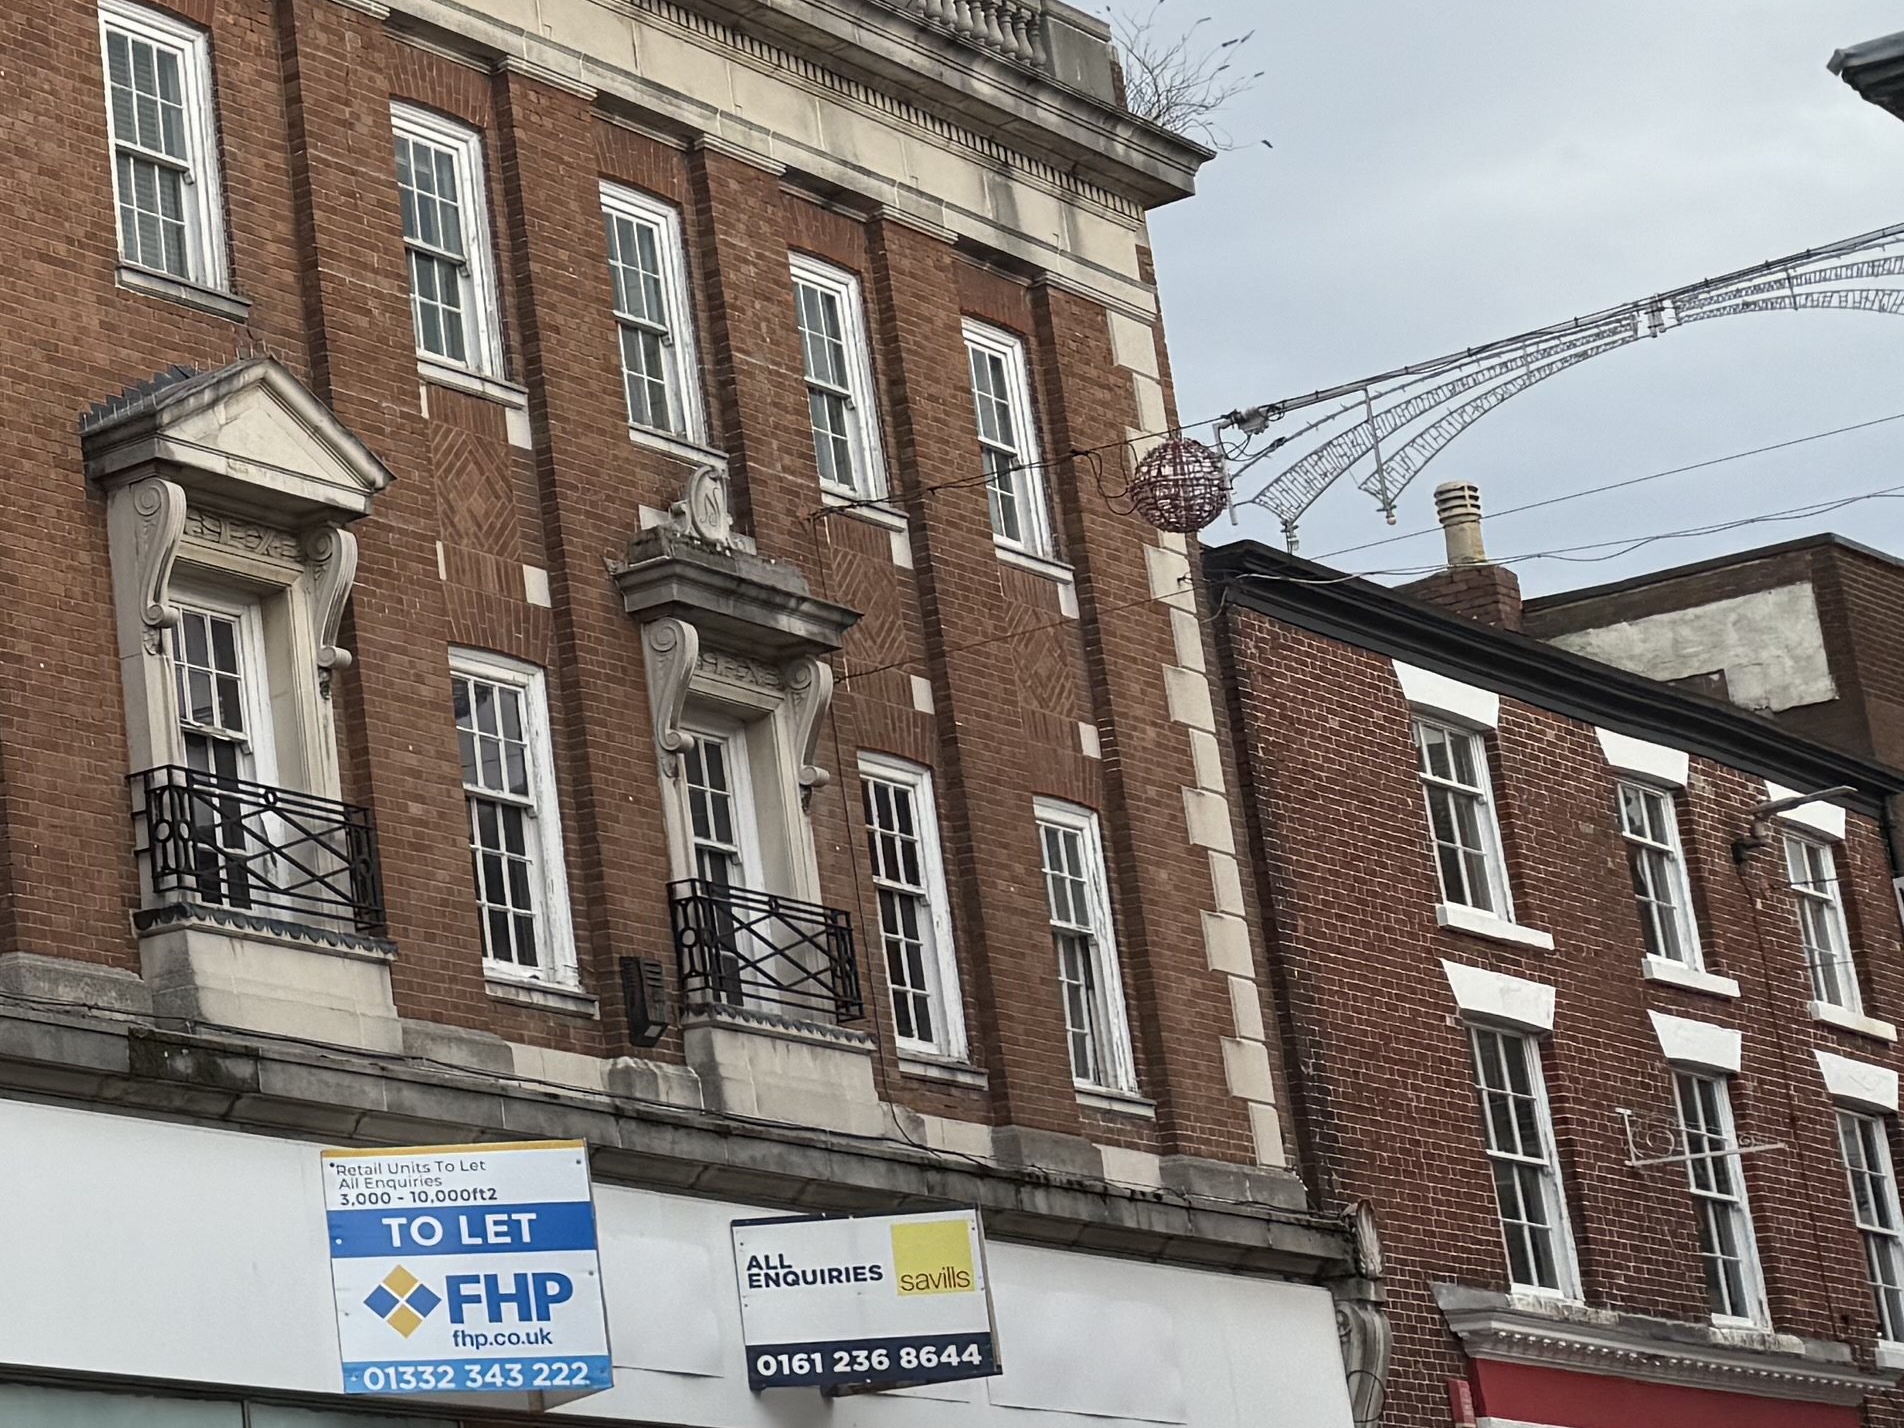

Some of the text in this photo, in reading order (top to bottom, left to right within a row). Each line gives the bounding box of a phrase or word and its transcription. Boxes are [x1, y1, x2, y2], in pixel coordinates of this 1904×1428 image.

[336, 1159, 486, 1177] Retail Units To Let
[338, 1175, 443, 1191] All Enquiries
[340, 1192, 392, 1207] 3,000
[412, 1188, 498, 1204] 10,000ft2
[381, 1213, 537, 1248] TO LET
[746, 1253, 793, 1271] ALL
[748, 1264, 884, 1289] ENQUIRIES
[900, 1266, 971, 1292] savills
[445, 1272, 574, 1325] FHP
[453, 1327, 553, 1350] fhp.co.uk
[756, 1343, 982, 1376] 0161 236 8644
[363, 1361, 590, 1390] 01332 343 222
